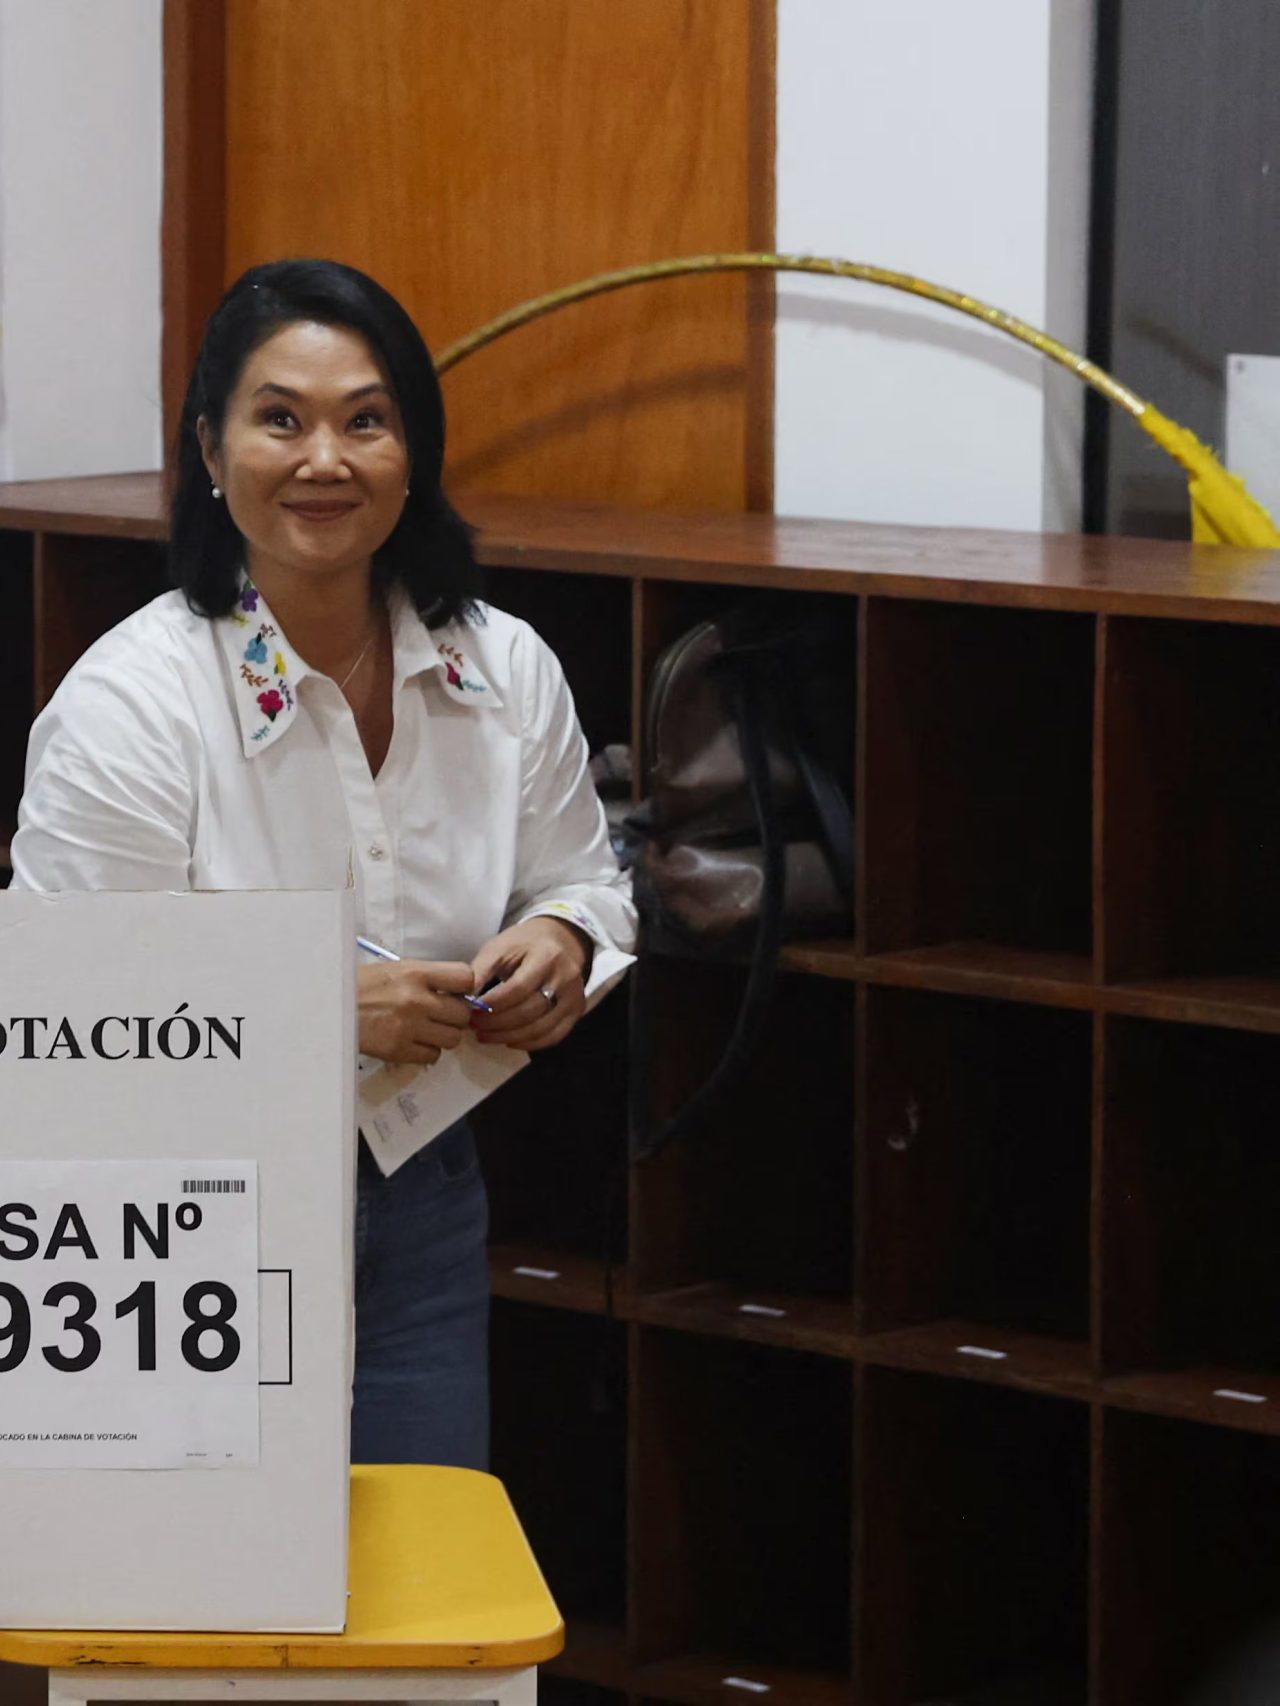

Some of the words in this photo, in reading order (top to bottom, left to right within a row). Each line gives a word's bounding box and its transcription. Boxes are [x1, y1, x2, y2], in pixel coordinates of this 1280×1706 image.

[27, 1433, 39, 1441] EN
[40, 1433, 51, 1441] LA
[52, 1433, 83, 1441] CABINA
[83, 1433, 95, 1441] DE
[96, 1431, 138, 1441] VOTACIÓN
